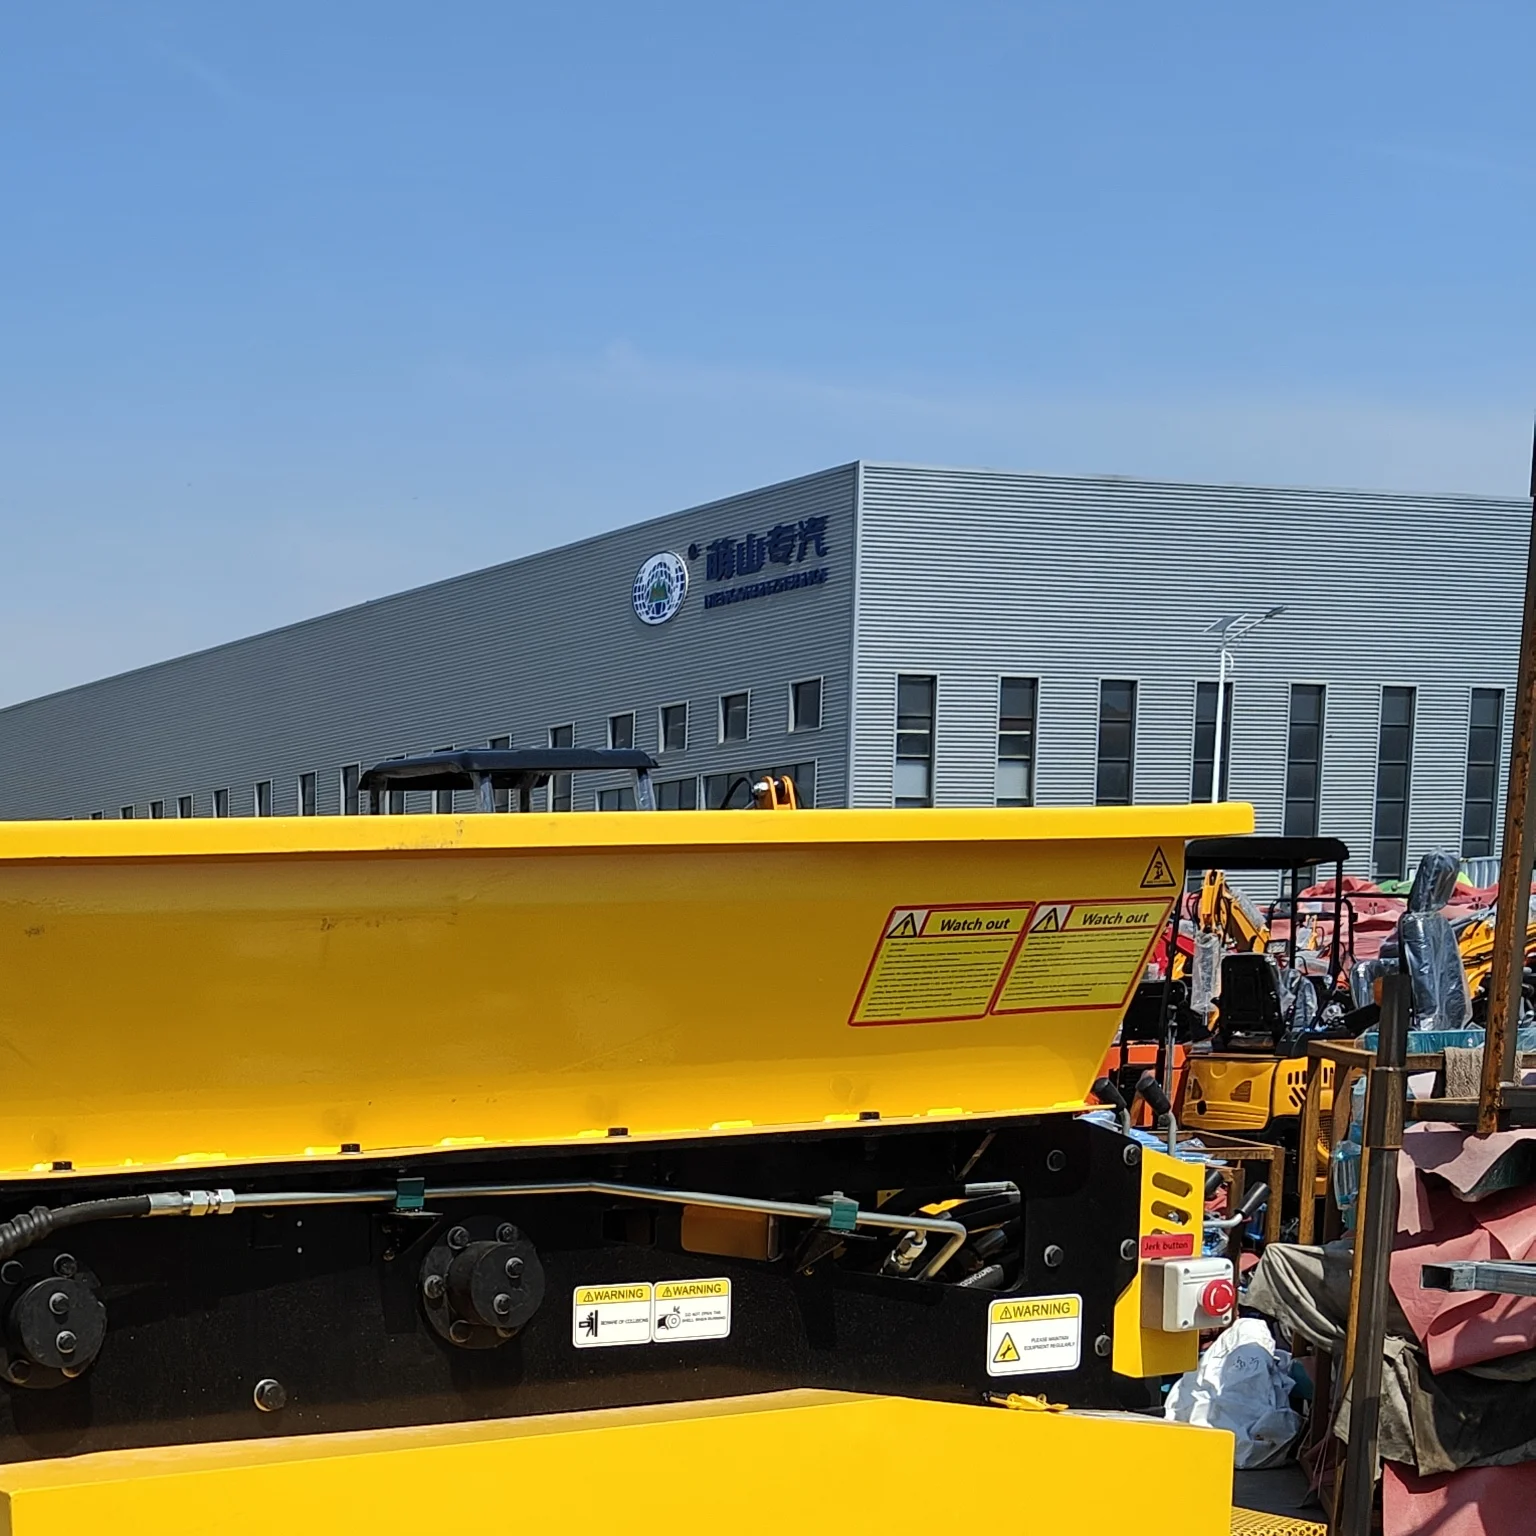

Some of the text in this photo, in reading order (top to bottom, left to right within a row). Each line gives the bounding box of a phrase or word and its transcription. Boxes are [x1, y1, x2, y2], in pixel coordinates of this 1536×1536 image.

[940, 917, 1011, 933] Watch out
[1081, 911, 1150, 926] Watch out
[1144, 1239, 1189, 1251] Jerk button
[593, 1288, 644, 1301] WARNING
[672, 1283, 722, 1297] WARNING
[1012, 1302, 1071, 1319] WARNING
